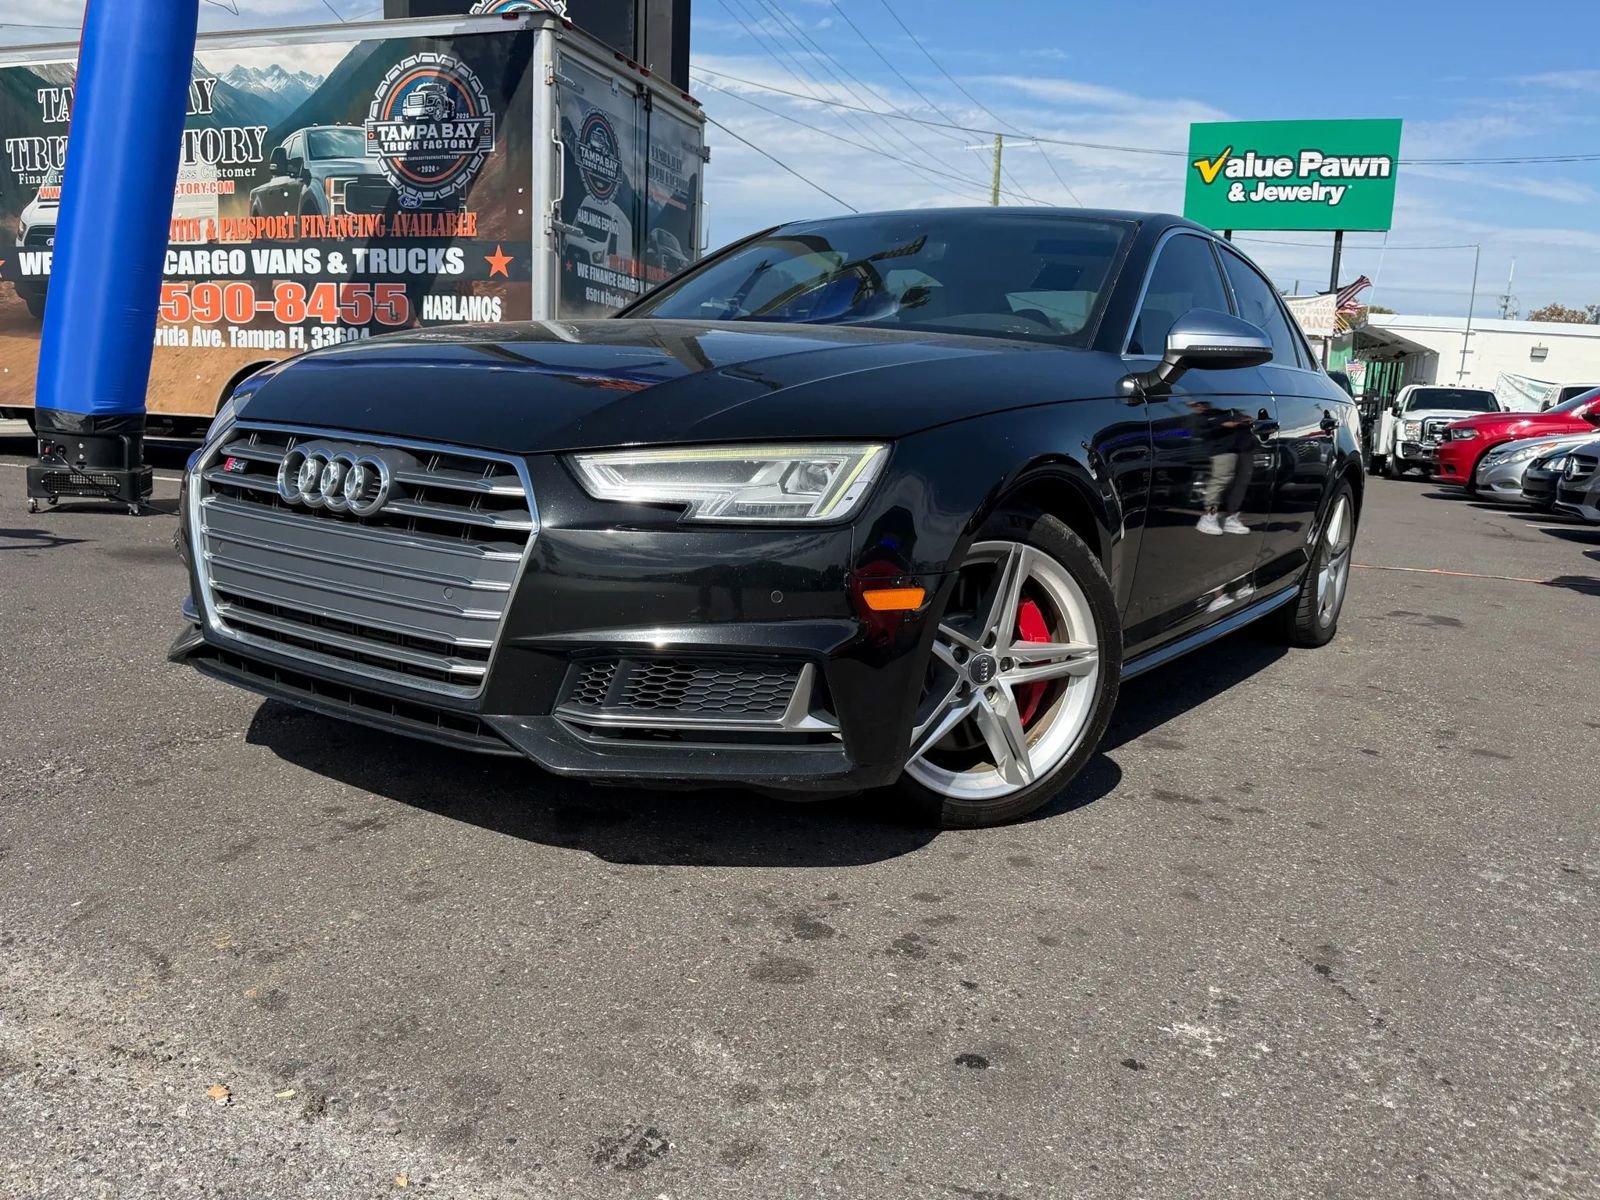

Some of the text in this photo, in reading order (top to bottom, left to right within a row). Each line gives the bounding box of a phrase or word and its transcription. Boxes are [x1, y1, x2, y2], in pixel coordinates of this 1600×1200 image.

[377, 122, 481, 141] TAMPA BAY
[5, 126, 267, 172] TRU TORY
[383, 139, 474, 151] TRUCK FACTORY
[580, 147, 618, 172] TAMPA BAY
[1299, 151, 1391, 177] Pawn
[201, 166, 257, 179] Customer
[176, 180, 235, 195] TORY.COM
[1227, 181, 1345, 205] & Jewelry
[206, 217, 218, 241] &
[219, 214, 297, 241] PASSPORT
[300, 213, 387, 240] FINANCING
[391, 212, 478, 238] AVAILABLE
[163, 249, 246, 275] CARGO
[250, 248, 323, 275] VANS
[327, 250, 348, 275] &
[352, 247, 465, 275] TRUCKS
[159, 282, 503, 326] 590-8455 HABLAMOS
[153, 325, 189, 346] rida
[191, 325, 226, 347] Ave.
[228, 326, 284, 351] Tampa
